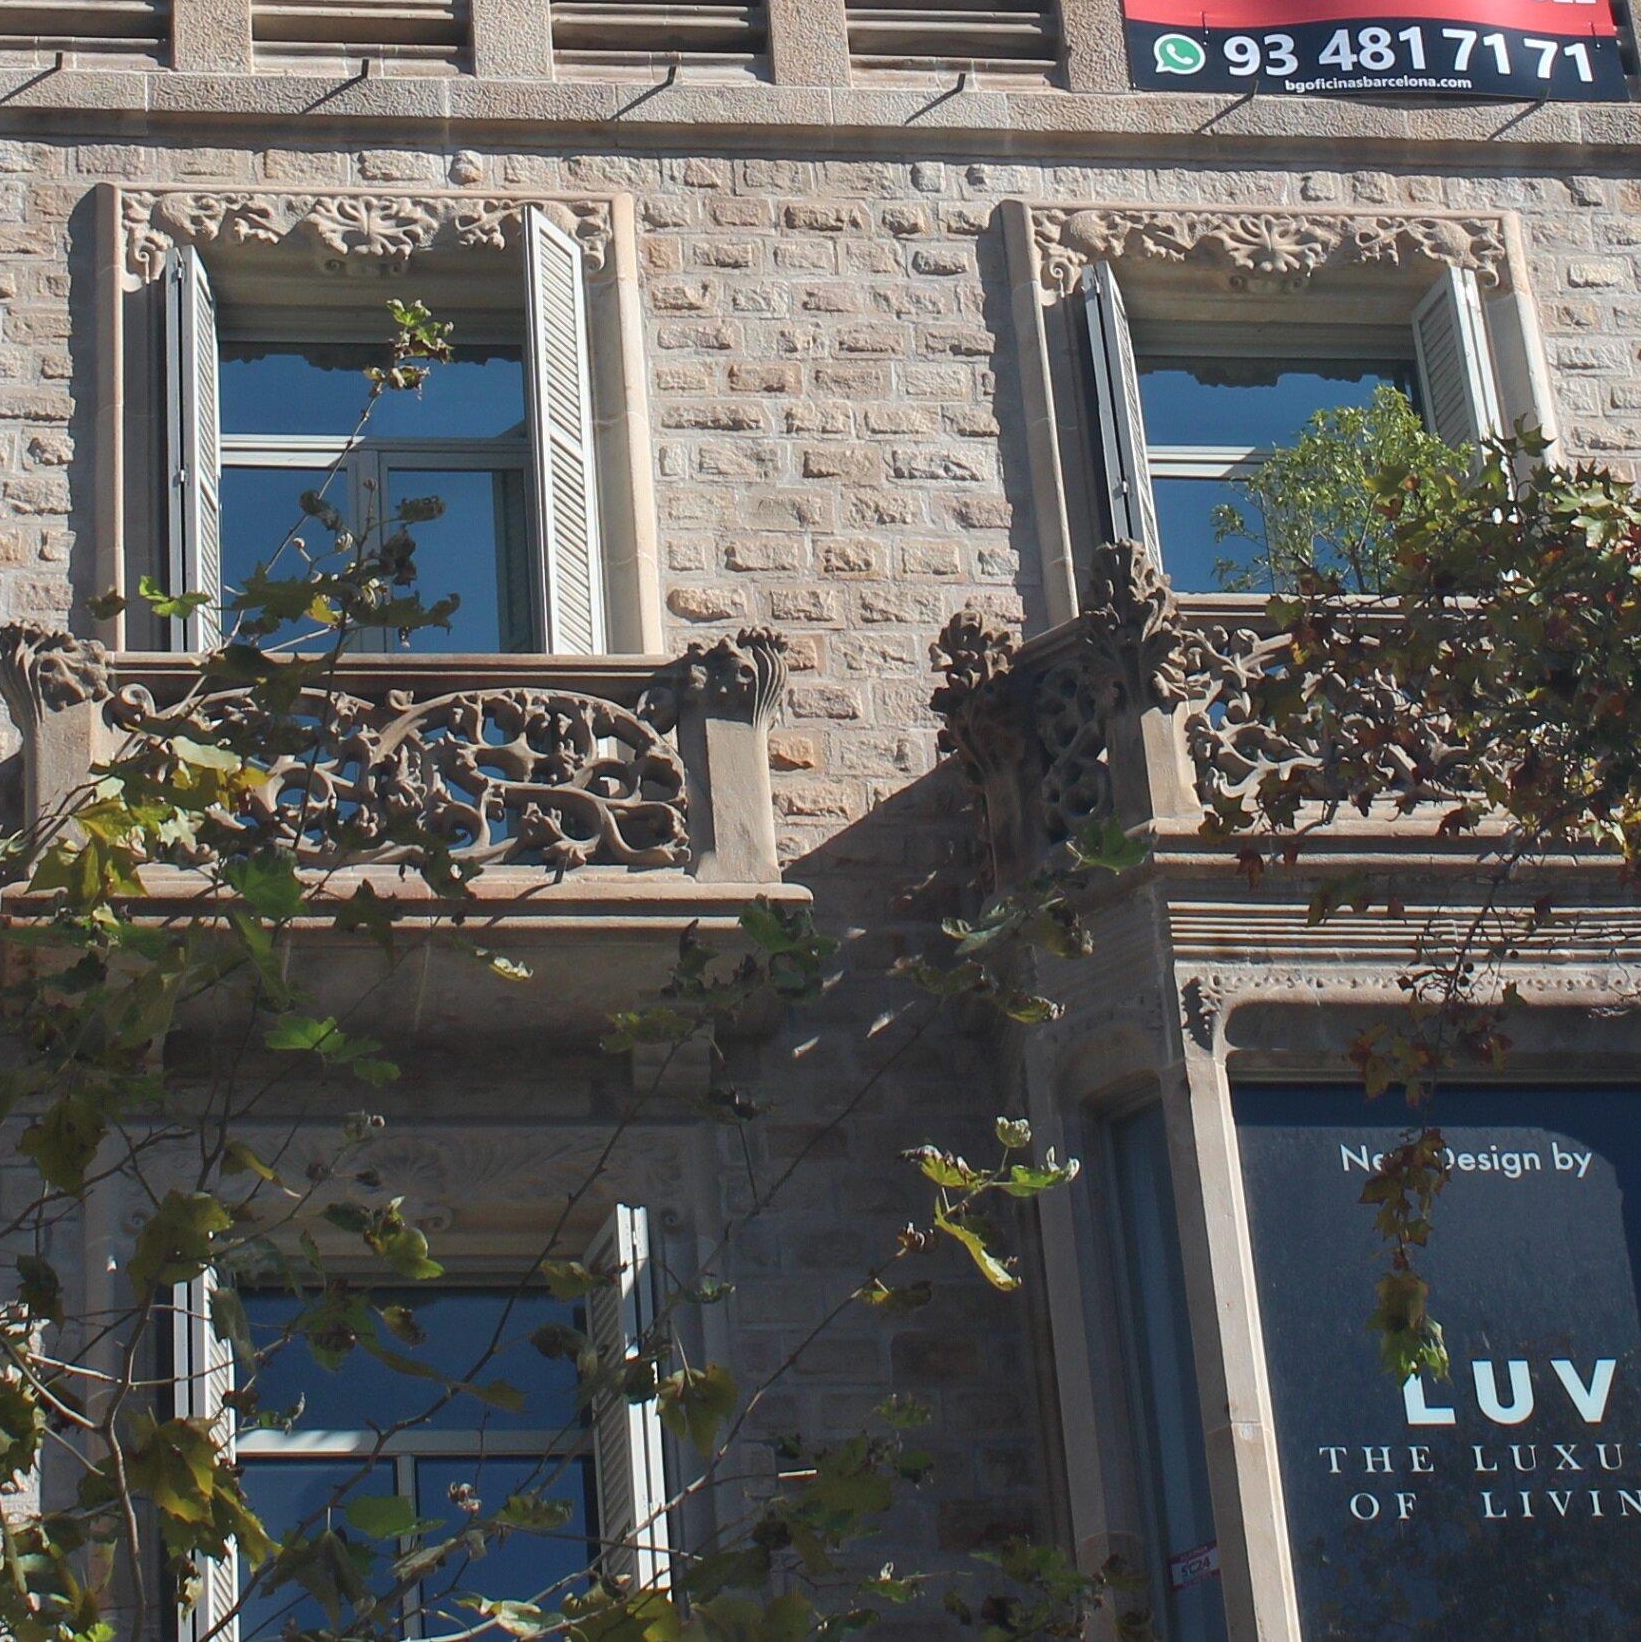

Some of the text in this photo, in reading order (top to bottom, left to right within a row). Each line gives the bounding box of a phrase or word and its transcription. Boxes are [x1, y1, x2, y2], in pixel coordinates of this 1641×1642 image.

[1223, 26, 1593, 83] 93 481 71 71
[1285, 74, 1472, 94] bgoficinasbarcelona.com
[1340, 1143, 1394, 1173] Ne
[1552, 1142, 1592, 1178] by
[1402, 1359, 1617, 1426] LUV
[1318, 1445, 1435, 1474] THE
[1349, 1491, 1418, 1521] OF
